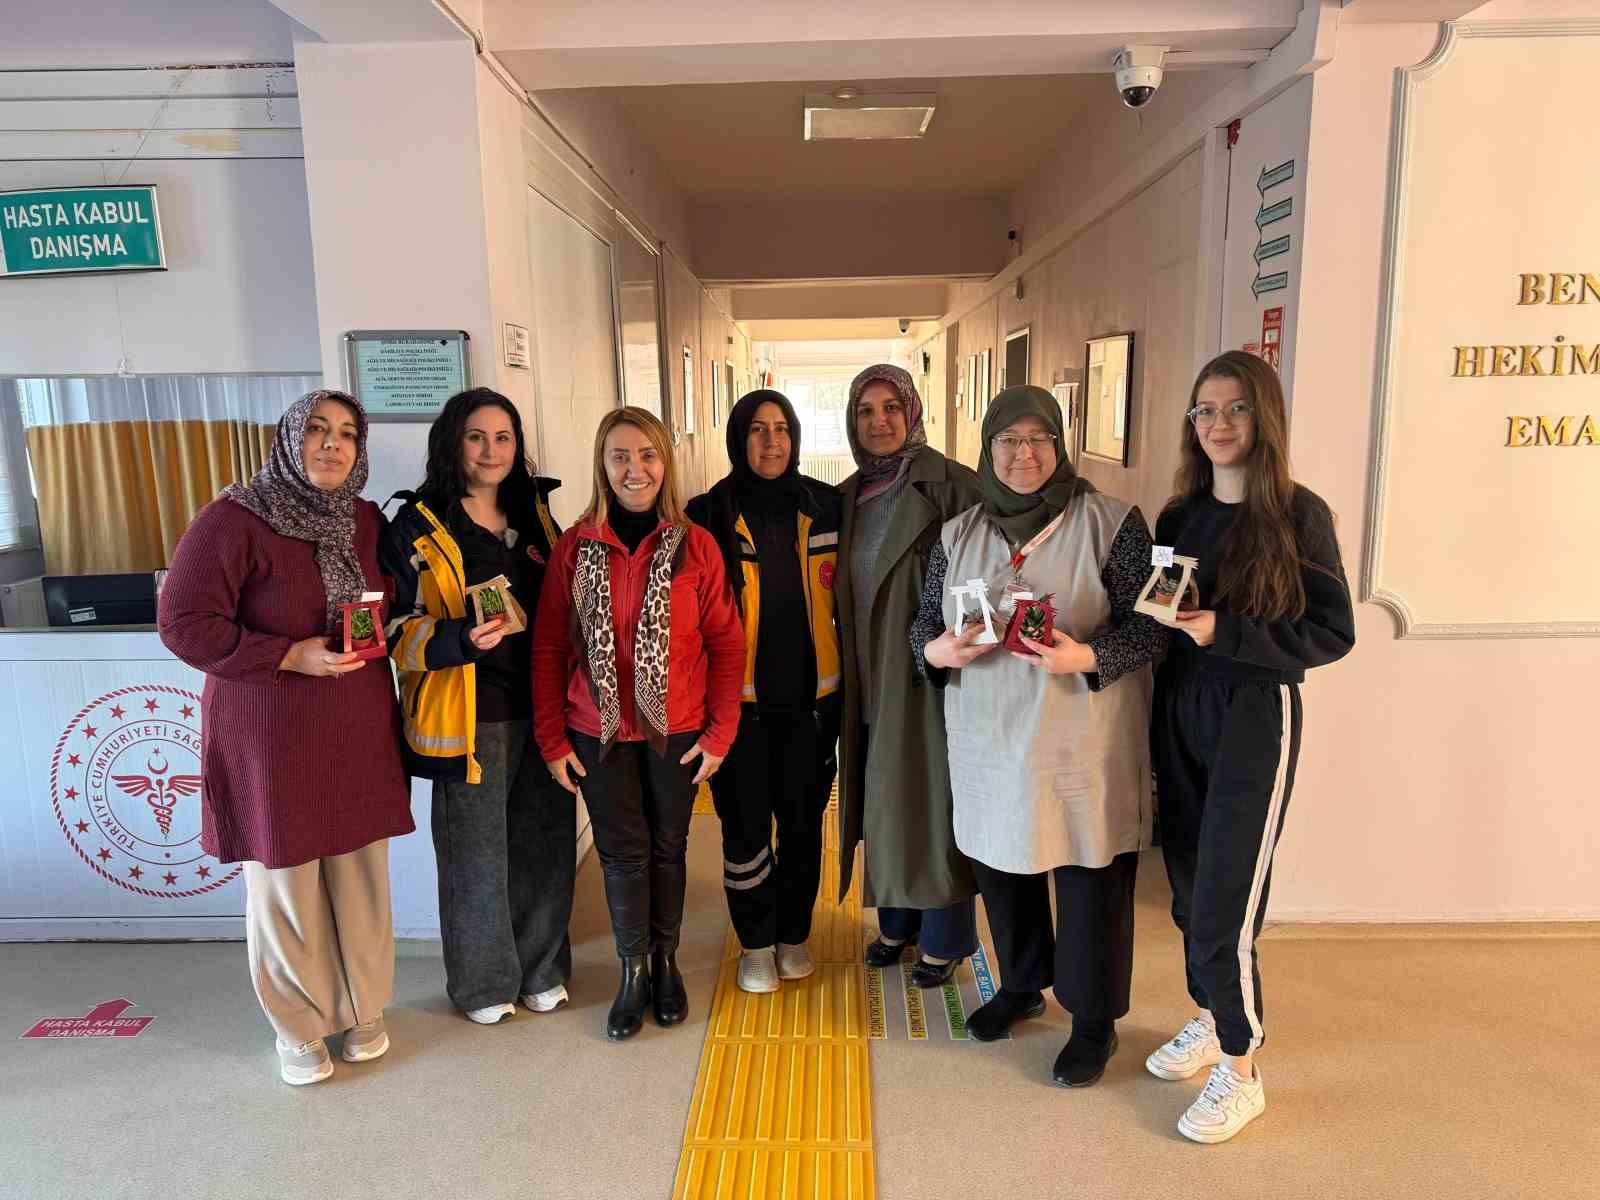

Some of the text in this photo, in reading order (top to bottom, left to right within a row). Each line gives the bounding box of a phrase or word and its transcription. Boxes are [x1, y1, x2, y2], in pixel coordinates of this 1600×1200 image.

[3, 201, 149, 229] HASTA KABUL
[30, 234, 128, 260] DANIŞMA
[1517, 272, 1600, 306] BEN
[1451, 335, 1600, 377] HEKİM
[1504, 415, 1600, 448] EMA
[91, 724, 167, 789] CUMHURİYETİ
[41, 1019, 143, 1028] HASTA KABUL
